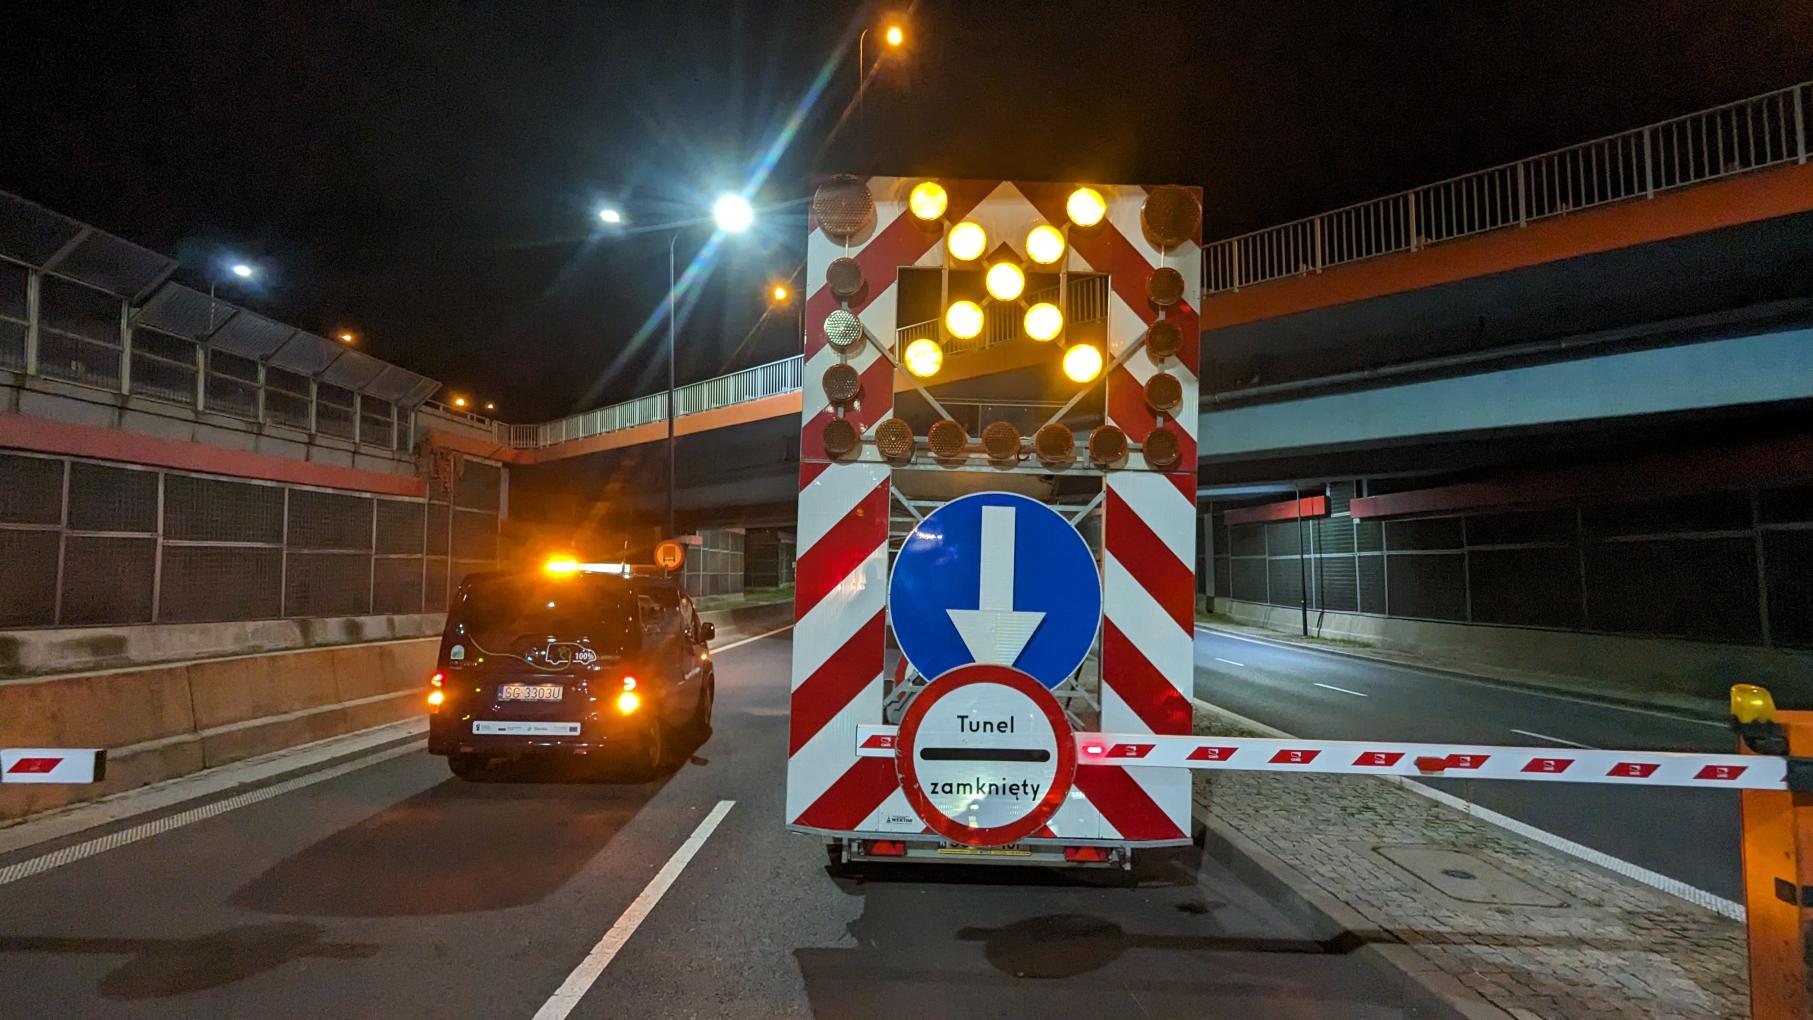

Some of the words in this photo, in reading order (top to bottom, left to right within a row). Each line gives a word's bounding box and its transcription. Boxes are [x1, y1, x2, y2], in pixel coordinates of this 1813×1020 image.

[575, 652, 595, 660] 100%
[505, 687, 520, 698] SG
[525, 687, 560, 699] 3303U
[956, 715, 1015, 733] Tunel
[930, 777, 1041, 801] zamknięty
